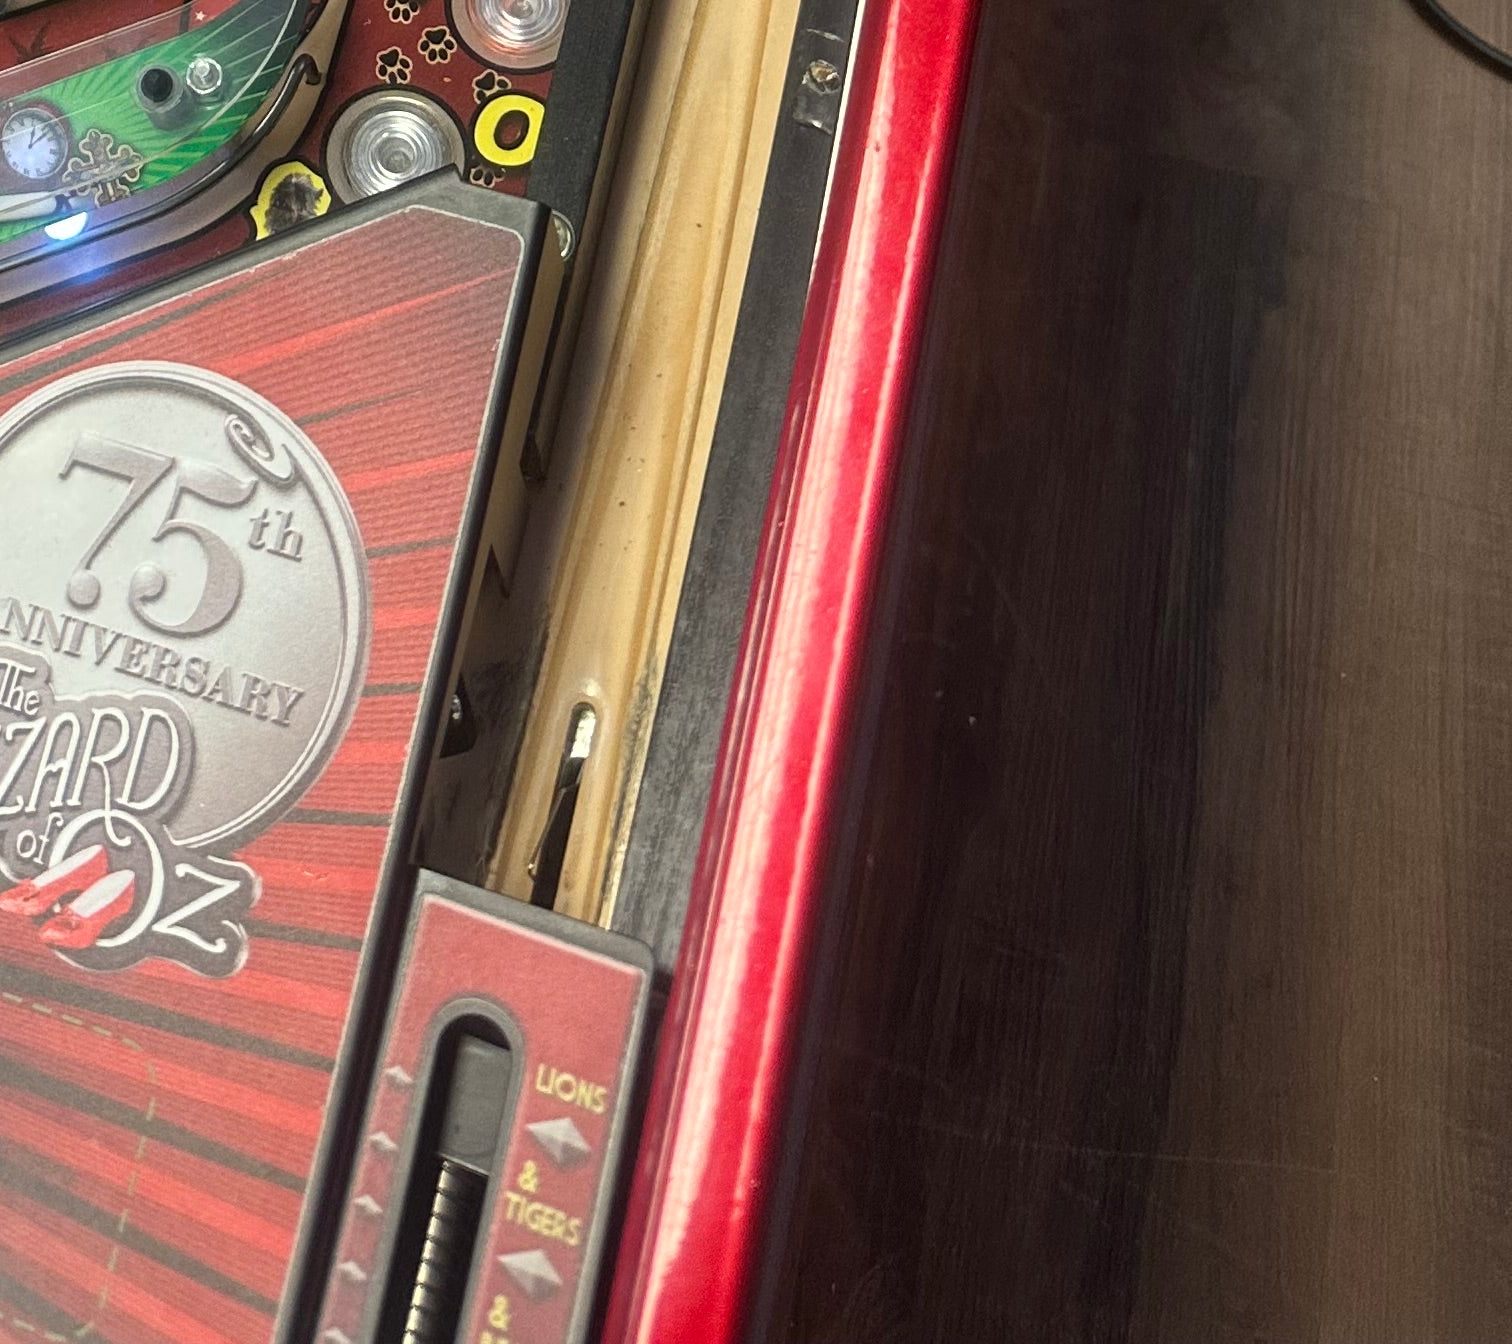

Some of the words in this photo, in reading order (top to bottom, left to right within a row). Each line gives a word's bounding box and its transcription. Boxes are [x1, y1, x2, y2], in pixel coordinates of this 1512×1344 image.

[15, 812, 65, 867] of
[535, 1063, 608, 1115] LIONS
[516, 1159, 539, 1193] &
[503, 1188, 584, 1248] TIGERS
[488, 1293, 511, 1332] &
